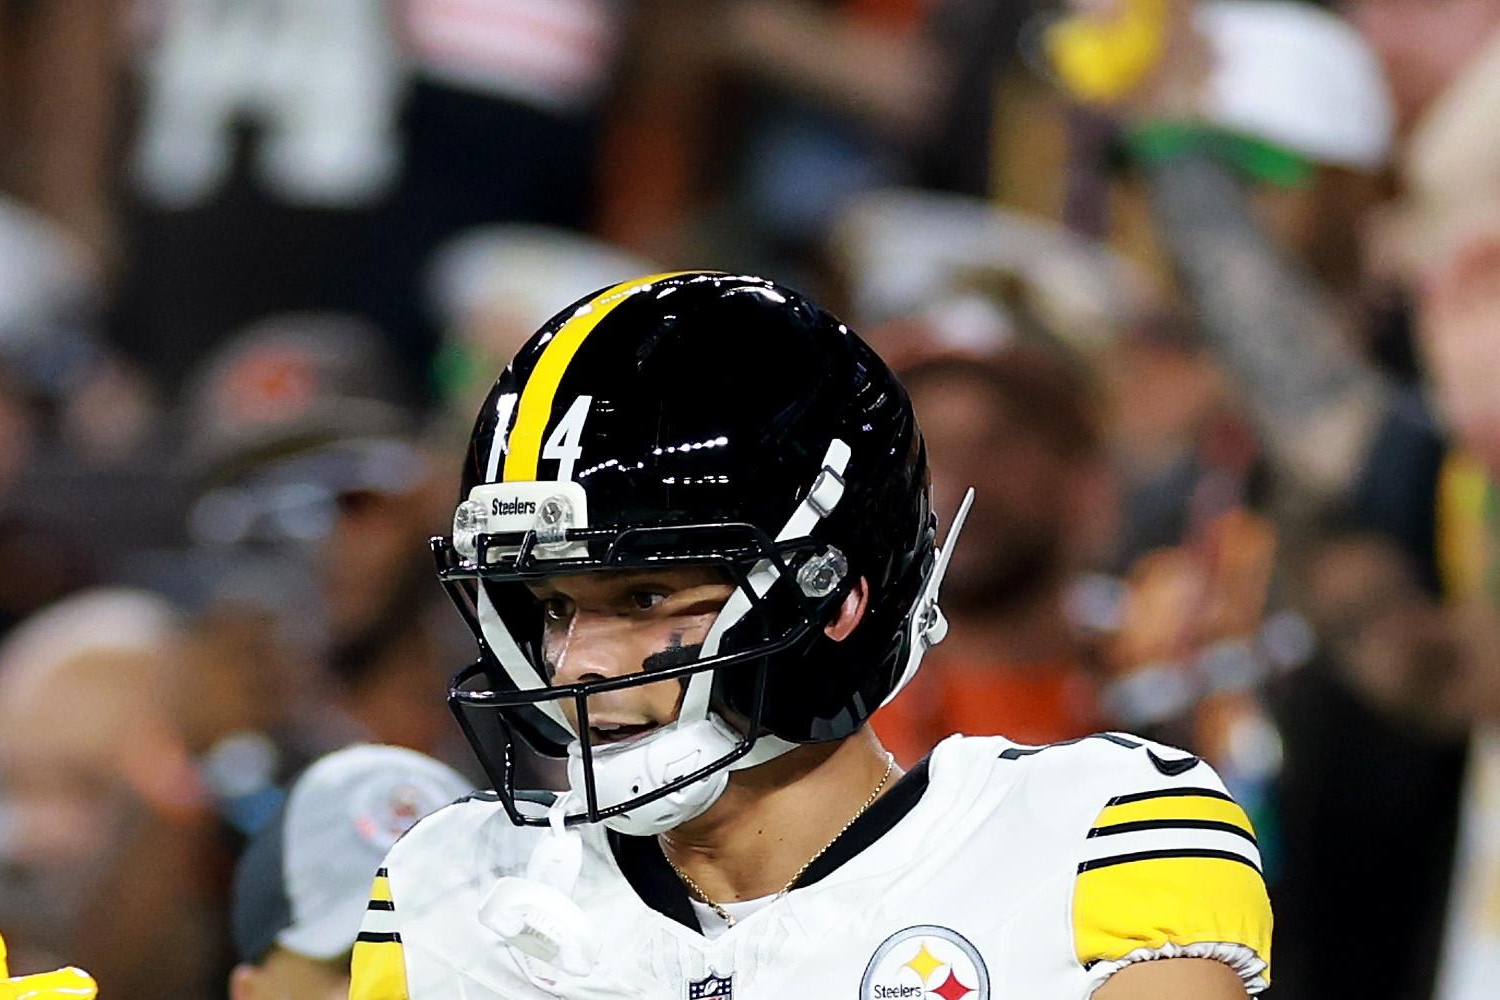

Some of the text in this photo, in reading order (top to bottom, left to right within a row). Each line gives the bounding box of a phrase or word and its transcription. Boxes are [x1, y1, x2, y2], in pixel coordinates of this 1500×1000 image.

[485, 393, 593, 483] 14
[491, 496, 537, 517] Steelers
[873, 982, 922, 1000] Steelers
